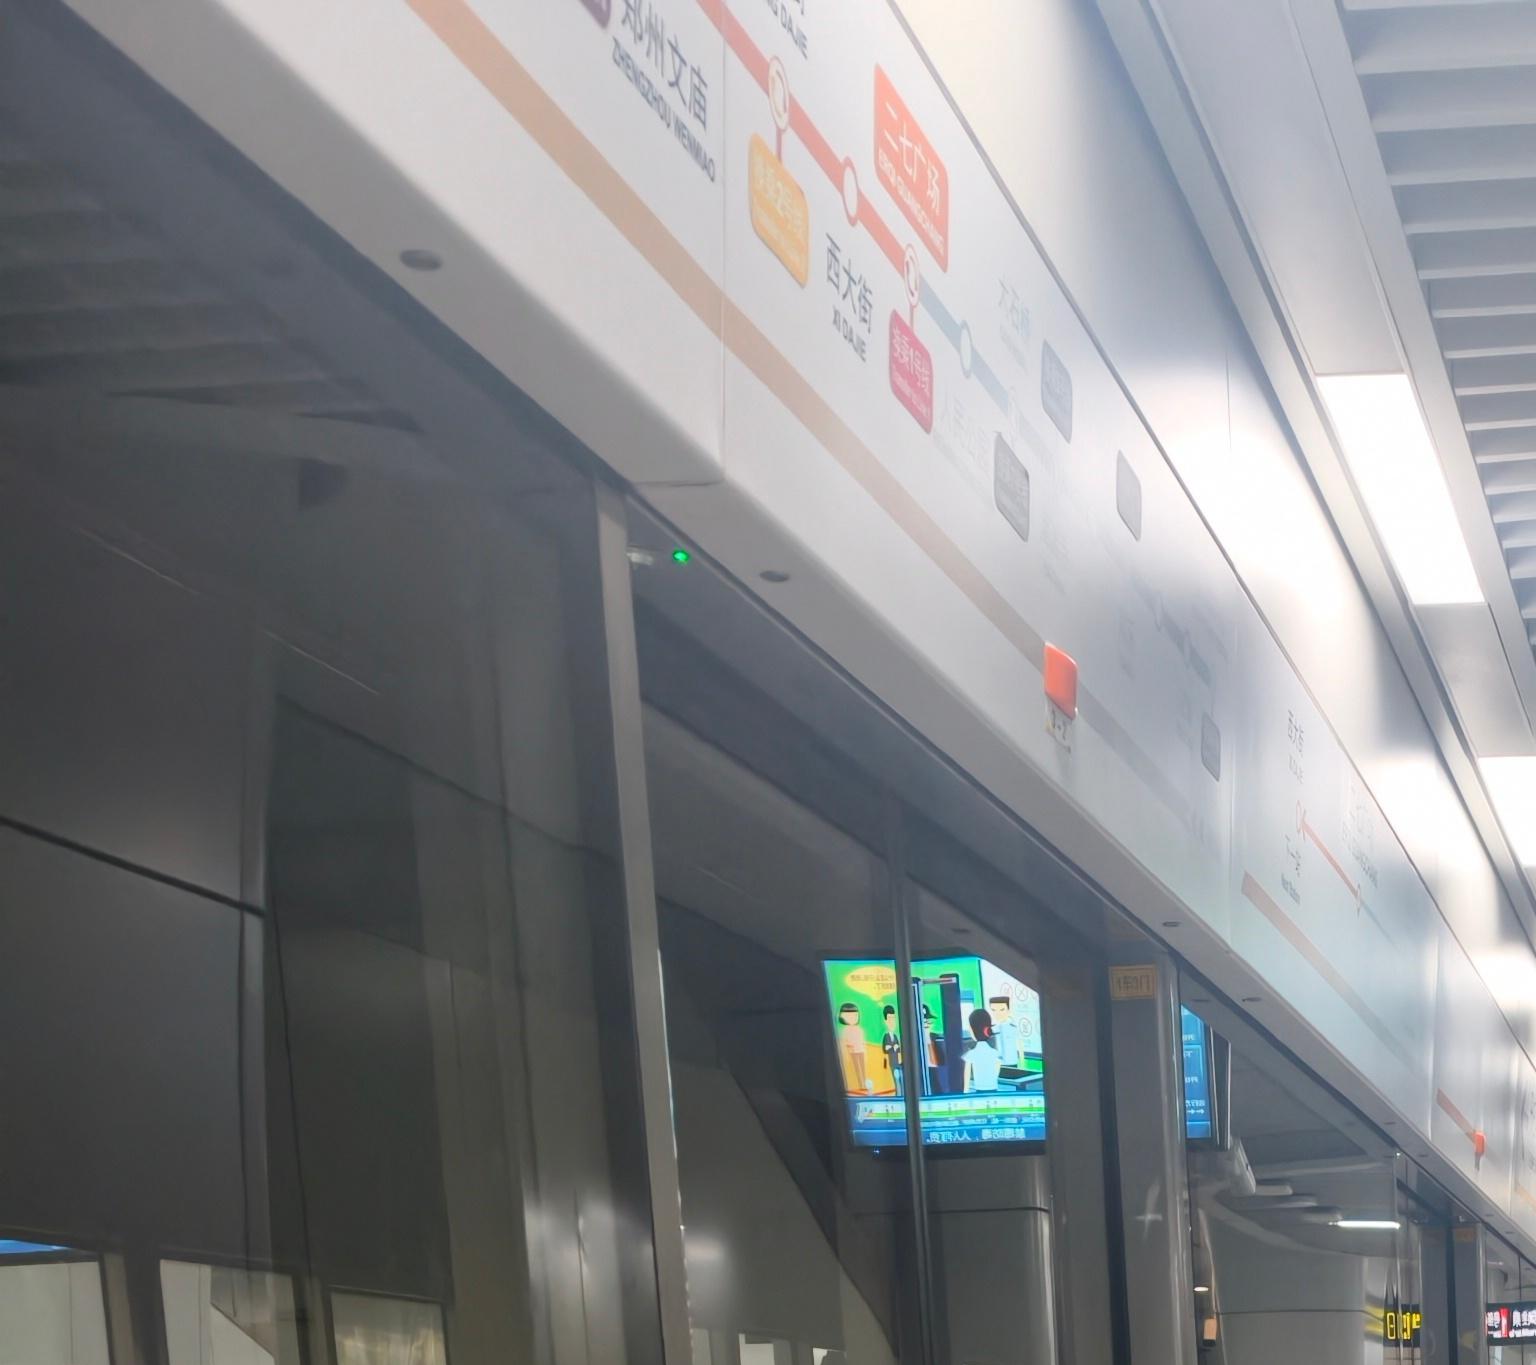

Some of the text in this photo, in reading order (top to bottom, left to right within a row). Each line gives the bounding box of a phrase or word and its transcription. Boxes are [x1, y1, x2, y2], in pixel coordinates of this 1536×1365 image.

[612, 35, 716, 183] ZHENGZHOU WENMIAO
[622, 0, 708, 130] 郑州文庙
[884, 101, 941, 216] 二七广场
[825, 233, 873, 334] 西大街
[842, 316, 867, 363] DAJIE
